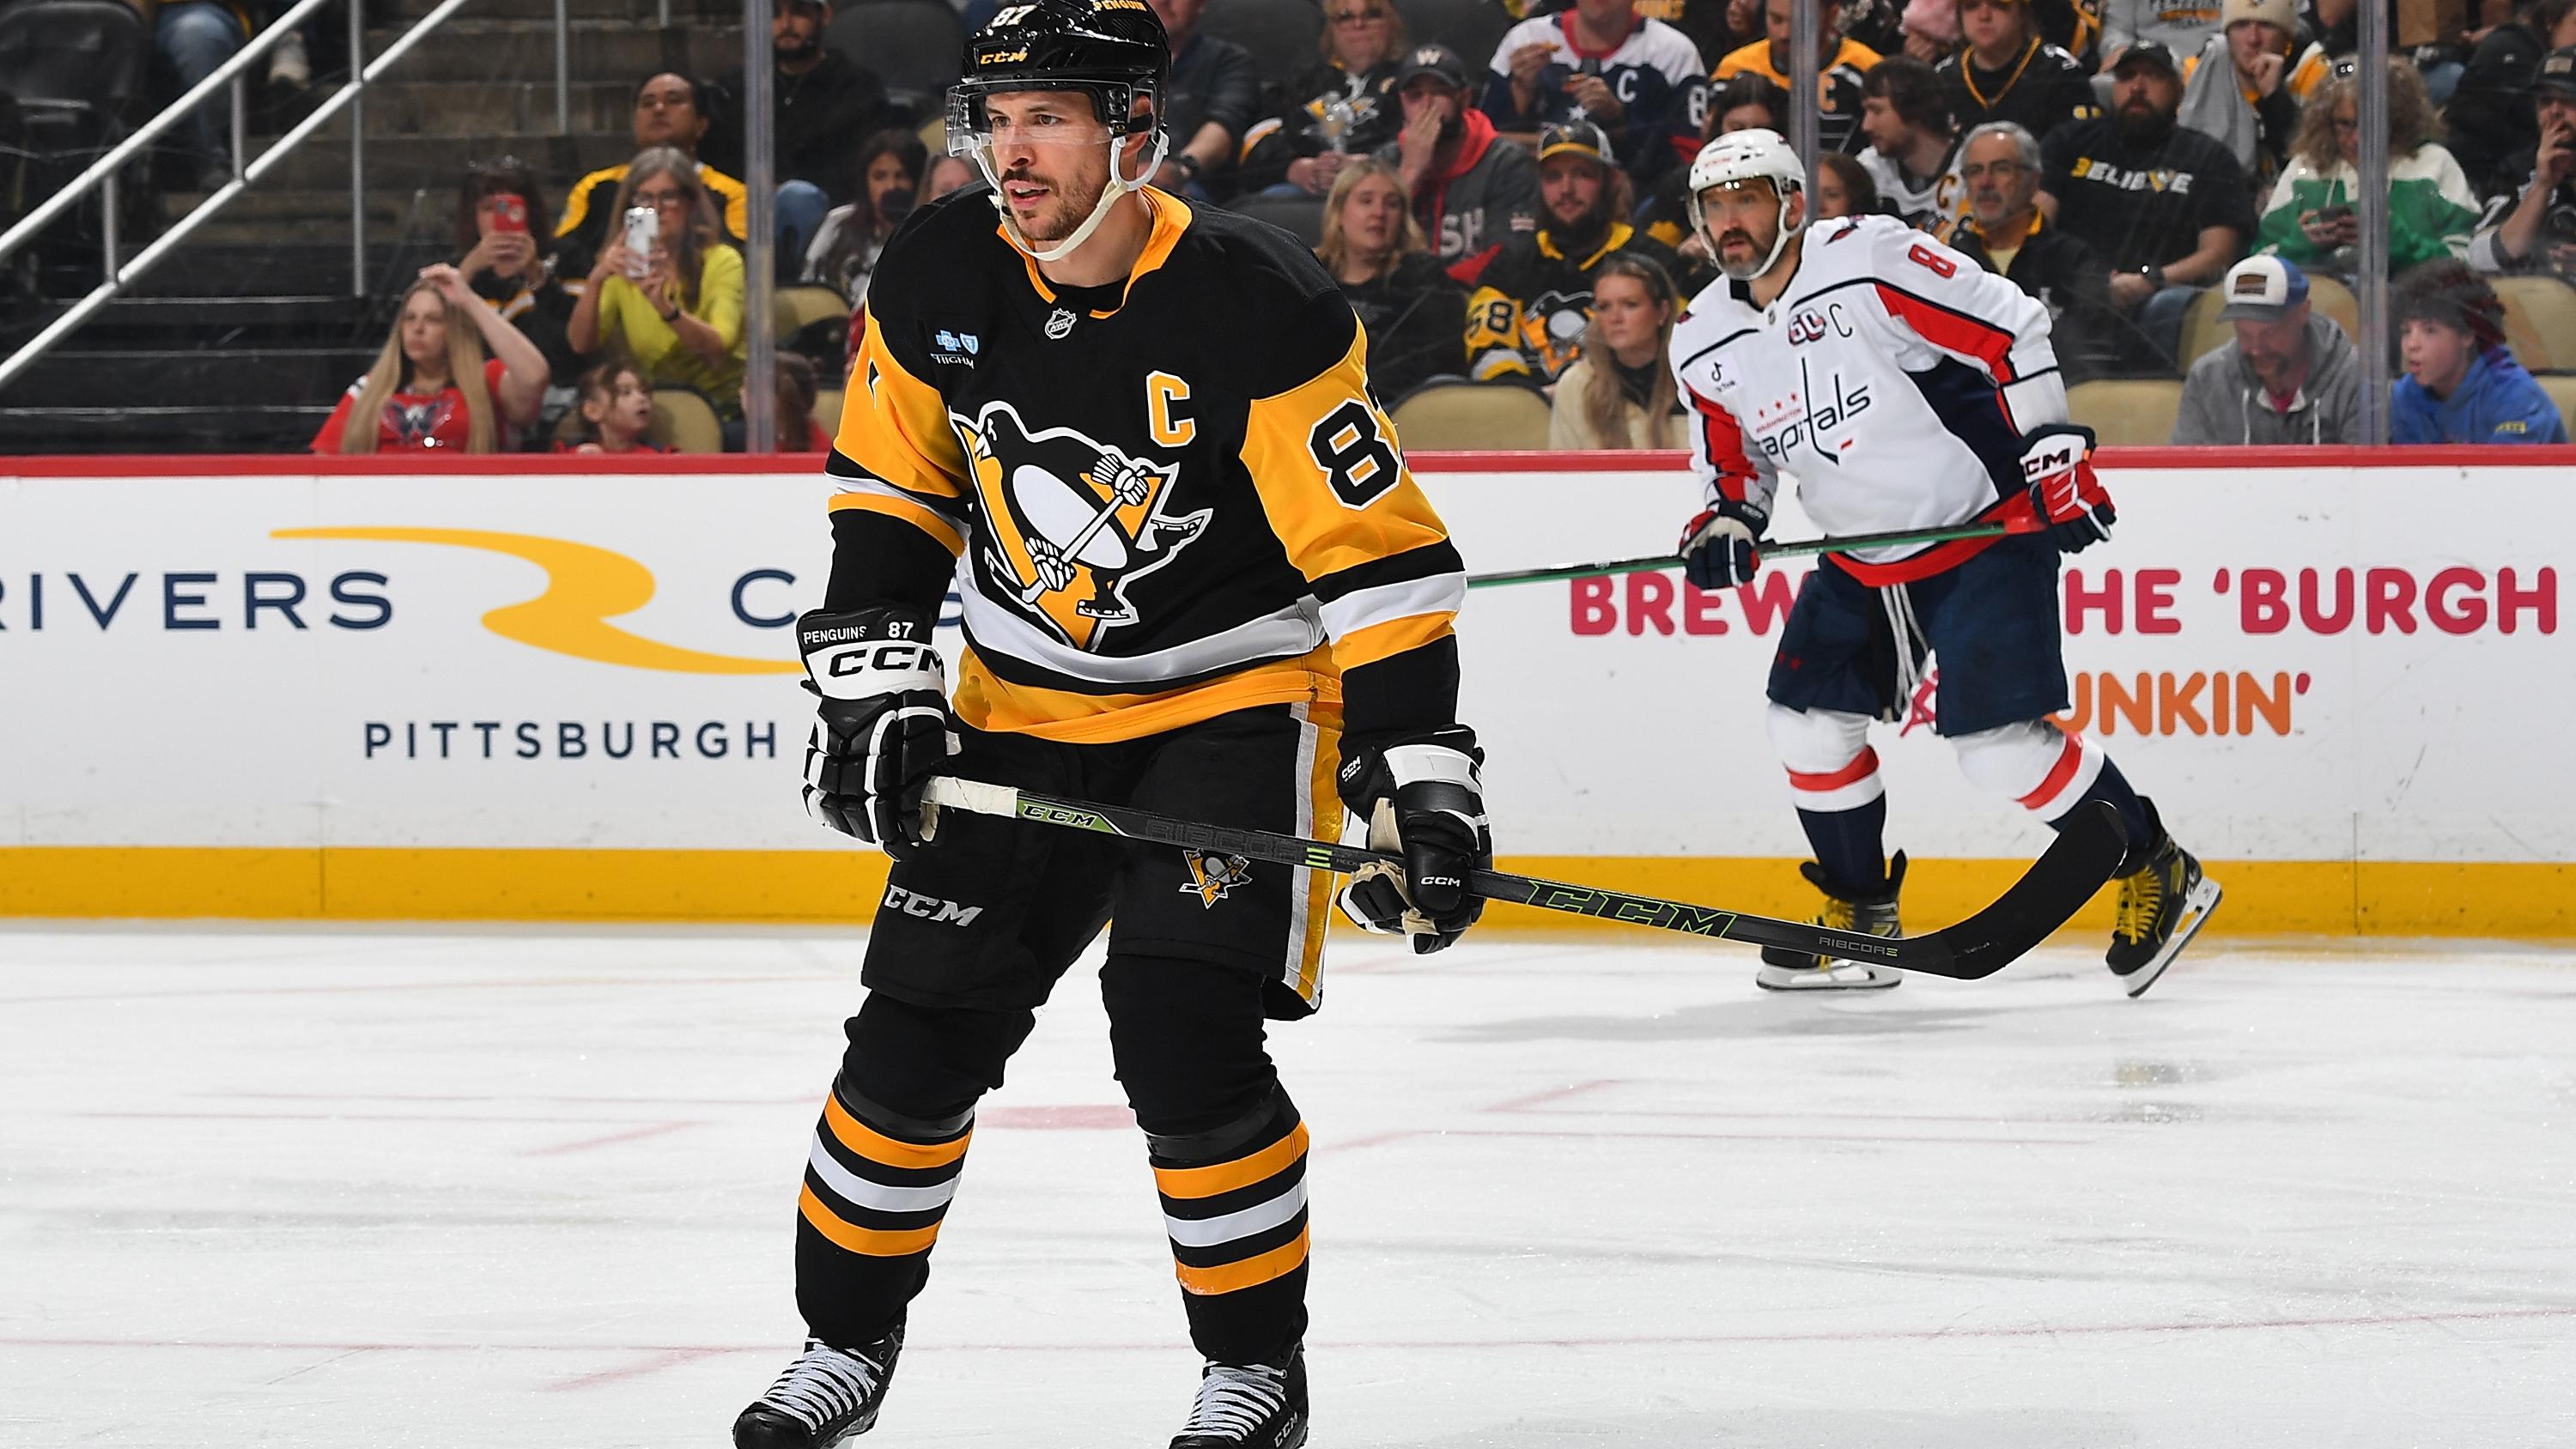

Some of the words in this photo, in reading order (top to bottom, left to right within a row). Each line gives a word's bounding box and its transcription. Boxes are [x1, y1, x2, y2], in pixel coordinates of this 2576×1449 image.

[991, 4, 1037, 27] 87
[980, 50, 1028, 64] CCM
[1416, 49, 1443, 65] W
[1616, 69, 1638, 103] C
[1936, 174, 1958, 209] C
[1908, 244, 1958, 279] 8
[1829, 303, 1853, 338] C
[1146, 370, 1196, 448] C
[1755, 357, 1871, 465] apitals
[0, 572, 392, 630] IVERS
[2213, 567, 2557, 635] 'BURGH
[803, 626, 867, 644] PENGUINS
[888, 621, 914, 639] 87
[829, 646, 945, 678] CCM
[365, 721, 776, 759] PITTSBURGH
[1341, 755, 1361, 779] CCM
[1022, 803, 1097, 828] CCM
[1421, 876, 1461, 888] CCM
[884, 884, 984, 927] CCM
[1527, 880, 1737, 938] CCM
[1819, 937, 1899, 957] RIBCORE
[1274, 1411, 1298, 1448] CCM
